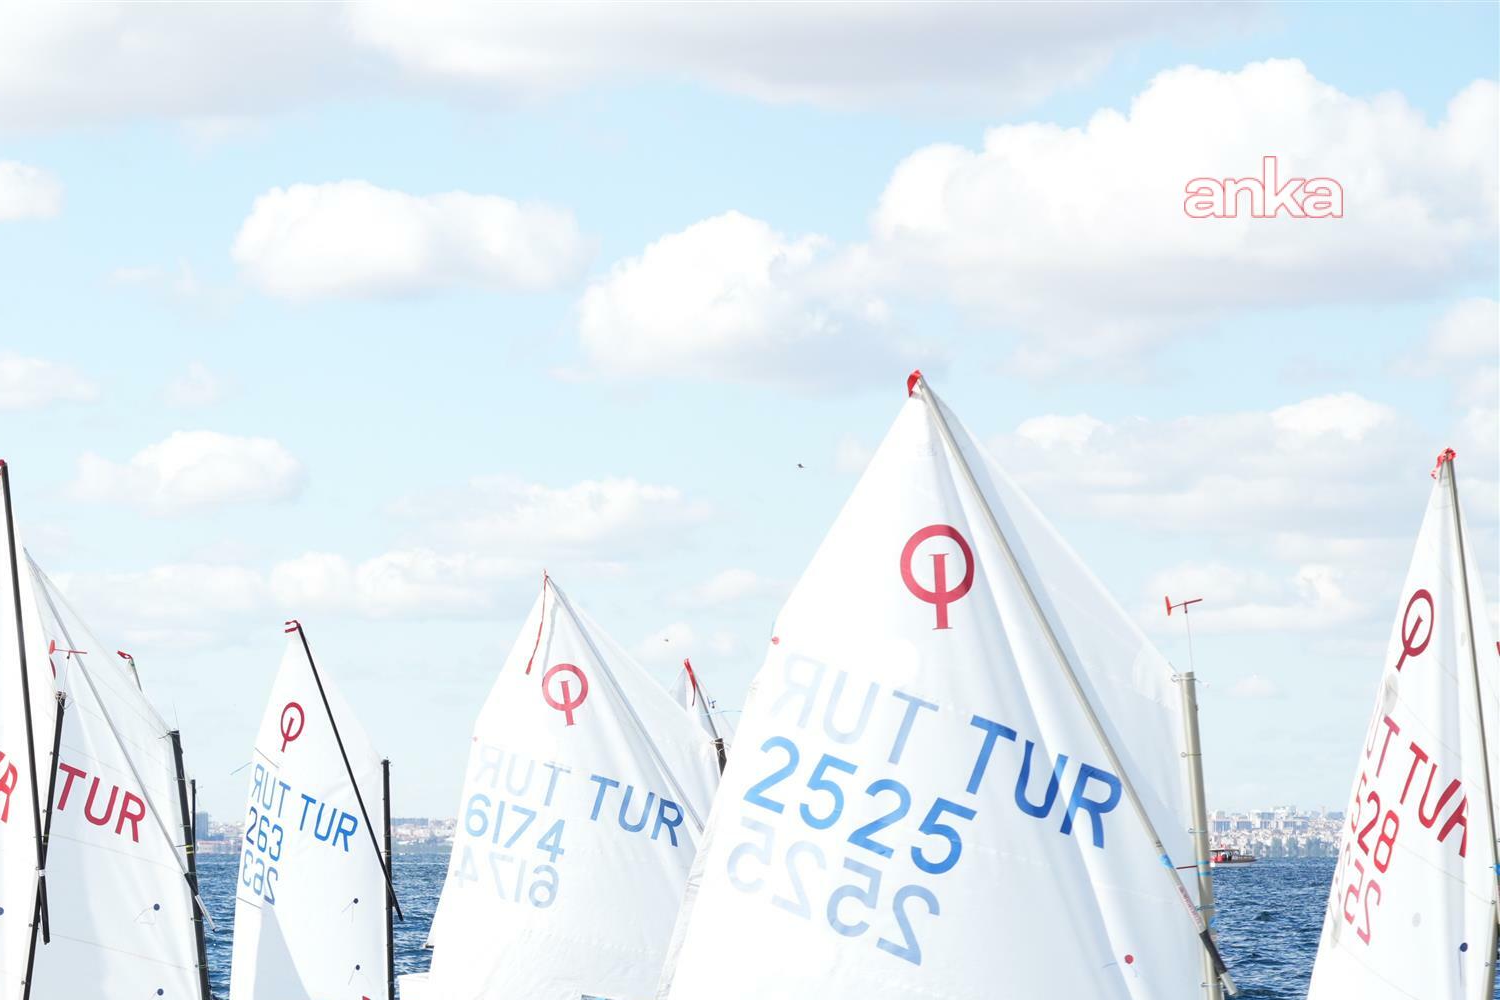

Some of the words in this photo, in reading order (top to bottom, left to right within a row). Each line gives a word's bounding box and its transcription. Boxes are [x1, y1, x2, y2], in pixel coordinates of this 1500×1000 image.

[57, 763, 146, 843] TUR
[590, 774, 684, 847] TUR
[743, 736, 978, 874] 2525
[965, 714, 1122, 849] TUR
[246, 806, 284, 862] 263
[300, 793, 358, 852] TUR
[465, 793, 565, 863] 6174
